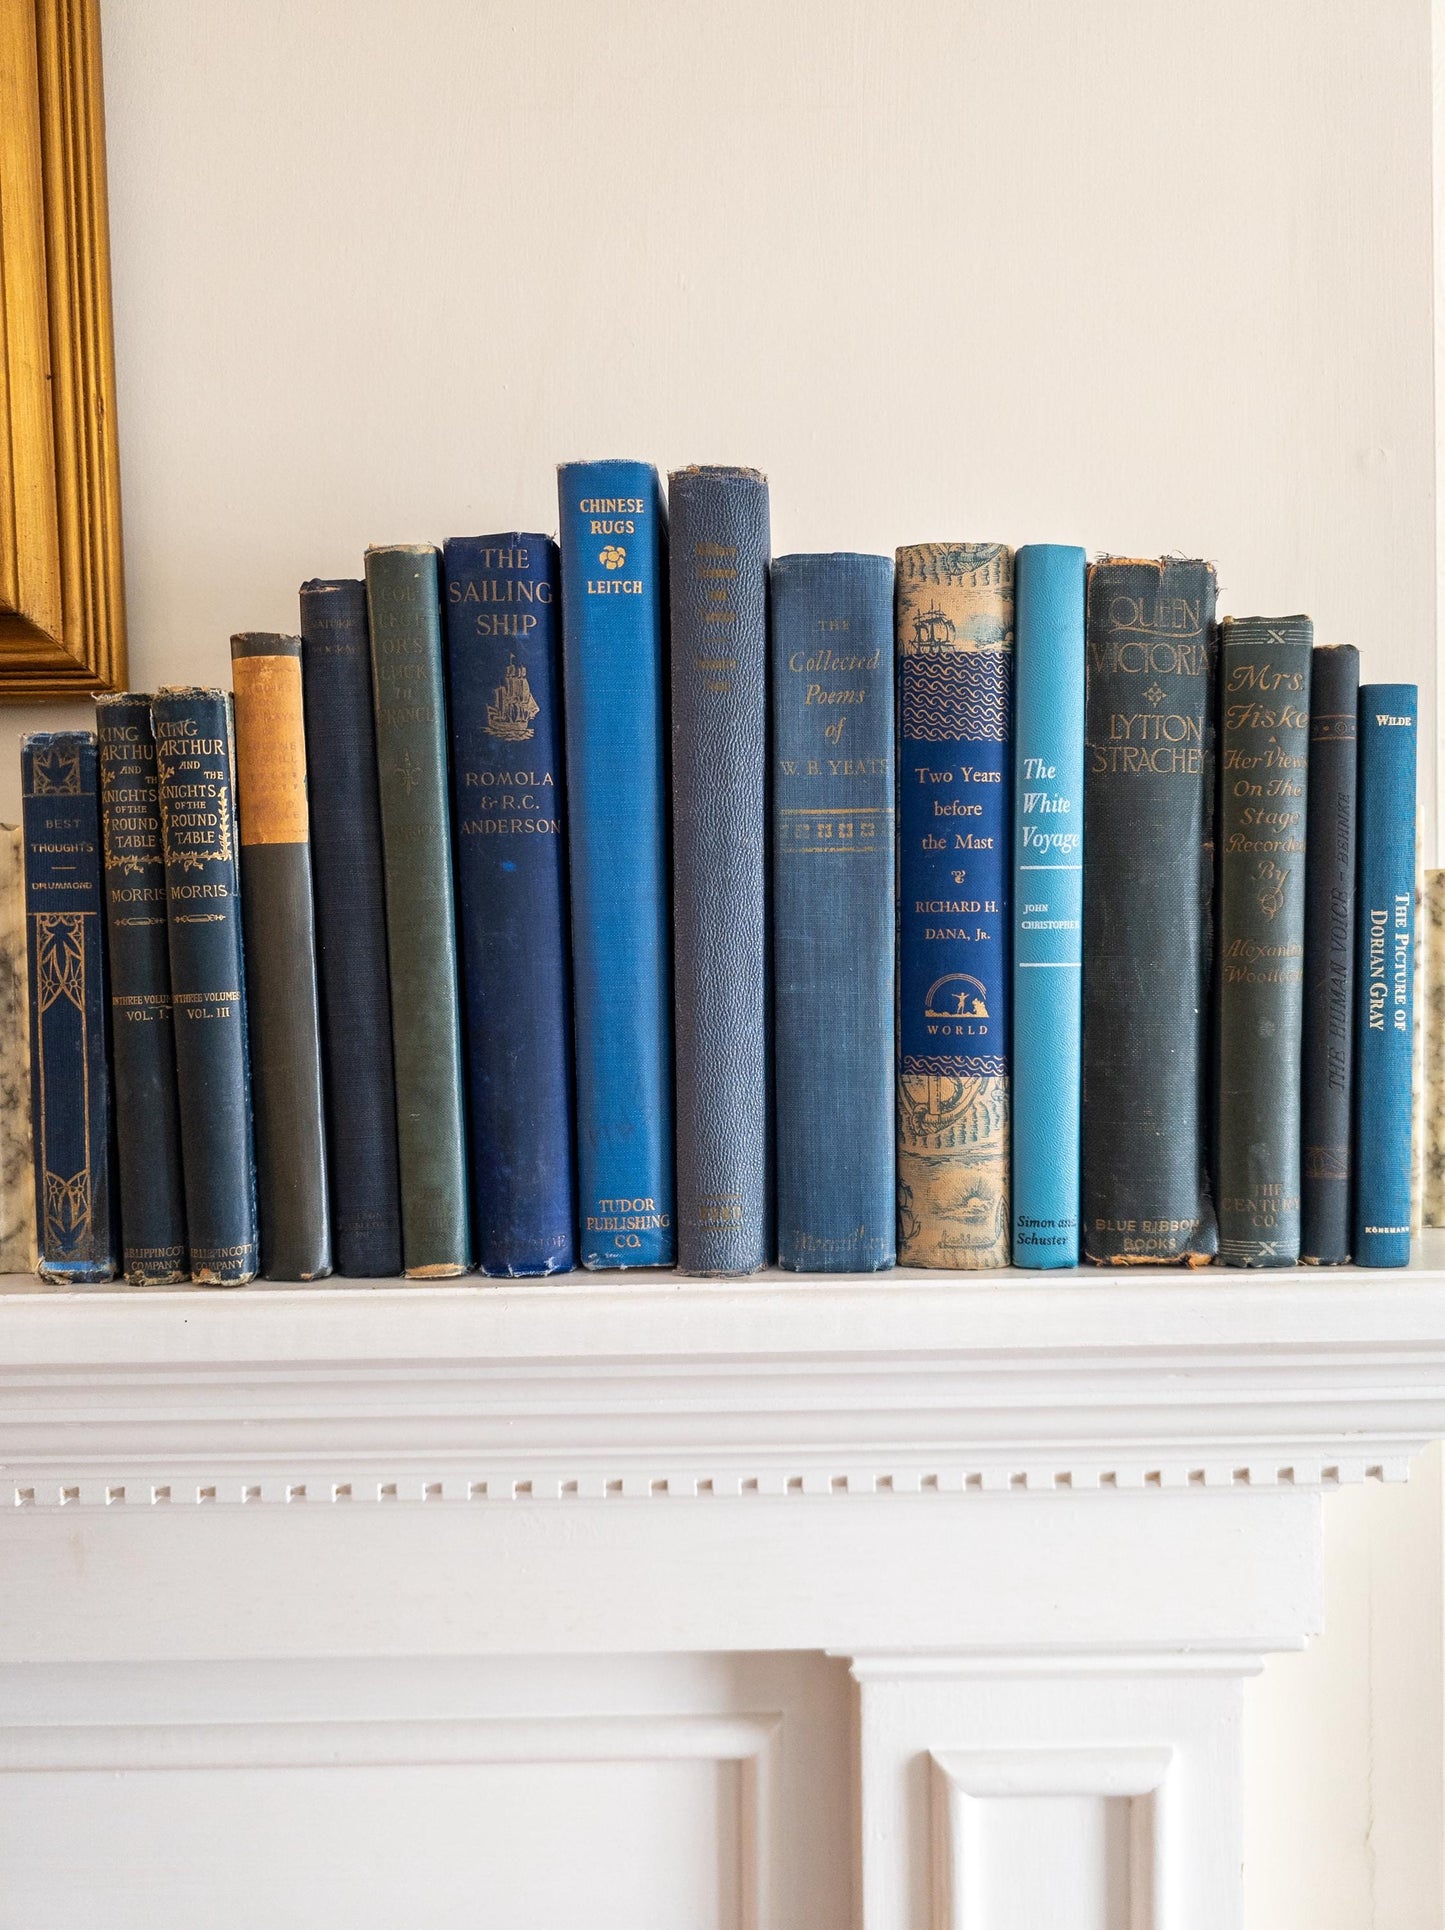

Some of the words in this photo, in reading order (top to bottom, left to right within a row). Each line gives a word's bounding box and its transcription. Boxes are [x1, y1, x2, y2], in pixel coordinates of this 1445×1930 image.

[580, 499, 644, 513] CHINESE
[590, 520, 635, 534] RUGS
[480, 548, 530, 569] THE
[449, 580, 553, 604] SAILING
[587, 580, 643, 594] LEITCH
[1109, 596, 1202, 635] QUEEN
[476, 614, 537, 636] SHIP
[818, 620, 850, 631] THE
[788, 648, 881, 673] Collected
[1090, 641, 1209, 676] VICTORIA
[1227, 664, 1304, 692] Mrs.
[805, 683, 866, 705] Poems
[1225, 702, 1309, 730] Fiske
[157, 720, 198, 738] KING
[824, 716, 847, 745] of
[1109, 713, 1205, 742] LYTTON
[101, 744, 154, 760] ARTHU
[159, 739, 226, 756] ARTHUR
[179, 760, 201, 770] AND
[829, 758, 888, 776] YEATS
[1092, 746, 1208, 774] STRACHEY
[1223, 749, 1262, 770] Her
[120, 765, 142, 775] AND
[203, 771, 224, 780] THE
[914, 767, 953, 784] Two
[960, 766, 1001, 783] Years
[1023, 758, 1056, 780] The
[145, 776, 158, 784] TH
[465, 771, 554, 786] ROMOLA
[161, 784, 217, 799] KNIGHTS
[1233, 779, 1262, 797] On
[1266, 778, 1302, 797] The
[933, 799, 983, 816] before
[1022, 792, 1071, 814] White
[45, 819, 82, 829] BEST
[112, 818, 158, 831] ROUND
[171, 813, 218, 828] ROUND
[461, 819, 561, 834] ANDERSON
[1239, 806, 1301, 834] Stage
[115, 835, 157, 848] TABLE
[174, 830, 215, 844] TABLE
[921, 833, 947, 850] the
[954, 833, 994, 849] Mast
[1021, 826, 1080, 854] Voyage
[31, 842, 94, 853] THOUGHTS
[32, 881, 93, 890] DRUMMOND
[171, 884, 228, 899] MORRIS
[915, 901, 981, 913] RICHARD
[984, 901, 999, 912] H.
[1023, 903, 1049, 915] JOHN
[1394, 892, 1410, 928] THE
[1021, 919, 1080, 930] CHRISTOPHER
[1330, 887, 1348, 953] VOICE
[925, 928, 971, 941] DANA,
[1370, 909, 1388, 979] DORIAN
[1394, 933, 1409, 1005] PICTURE
[143, 994, 169, 1005] VOLU
[203, 991, 240, 1002] VOLUMES
[1328, 960, 1347, 1040] HUMAN
[187, 1007, 214, 1019] VOL.
[216, 1006, 231, 1018] III
[1369, 982, 1389, 1031] GRAY
[126, 1010, 154, 1021] VOL.
[1394, 1009, 1407, 1031] OF
[927, 1025, 989, 1036] WORLD
[1328, 1044, 1346, 1091] THE
[599, 1198, 656, 1213] TUDOR
[1222, 1197, 1300, 1212] CENTURY
[586, 1214, 670, 1231] PUBLISHING
[1017, 1215, 1055, 1228] Simon
[1095, 1218, 1137, 1232] BLUE
[1017, 1232, 1067, 1246] Schuster
[1123, 1238, 1177, 1251] BOOKS
[131, 1259, 181, 1271] COMPANY
[195, 1259, 244, 1271] COMPANY
